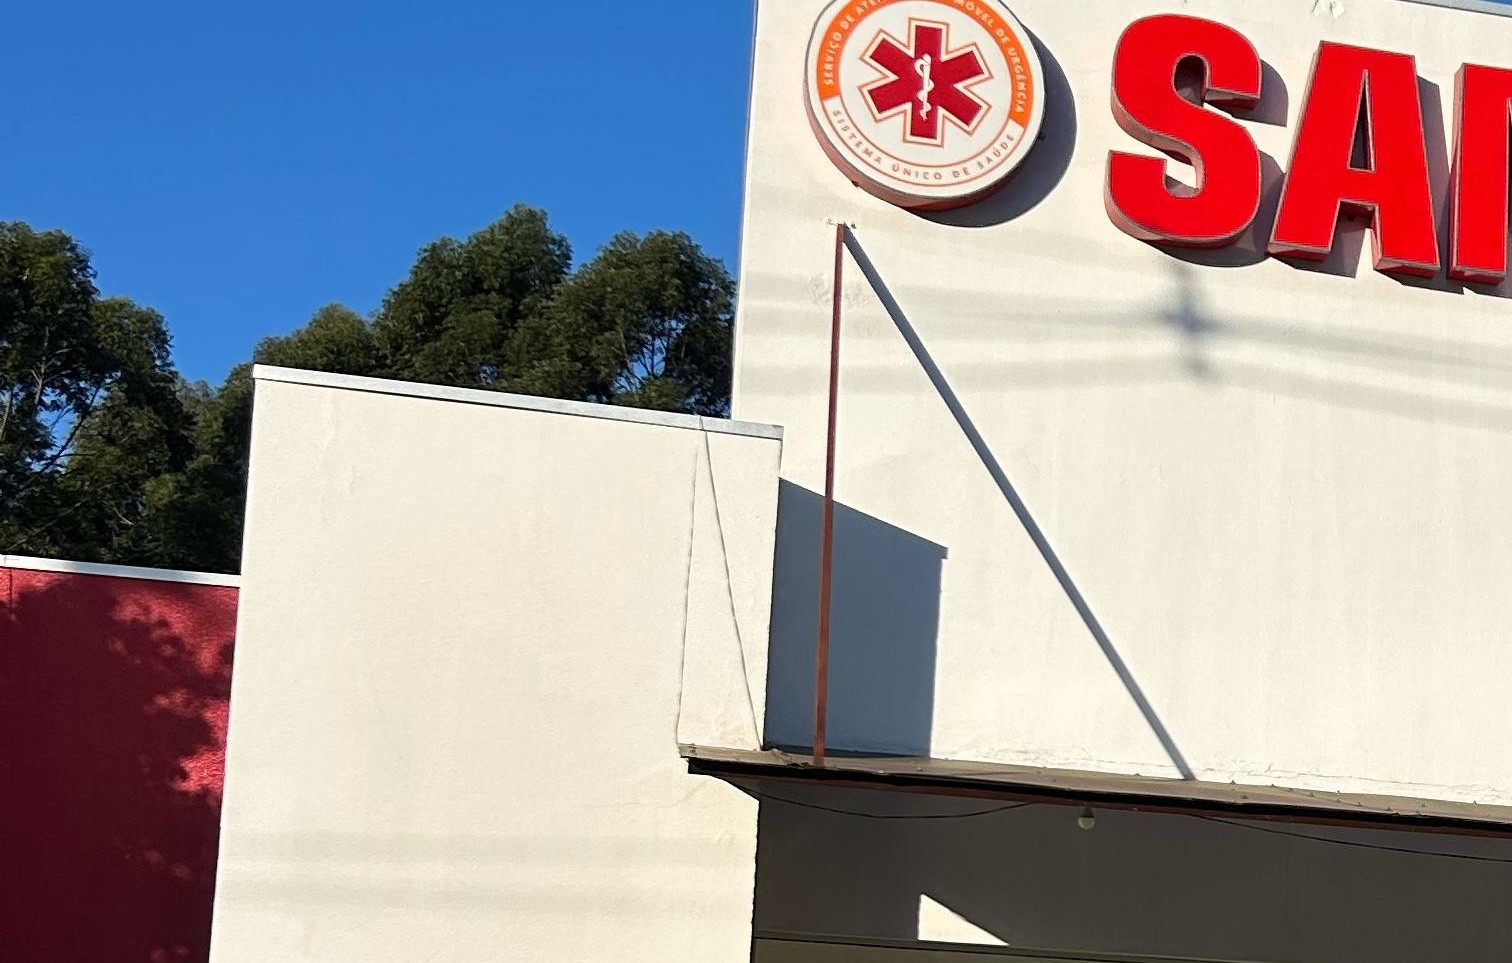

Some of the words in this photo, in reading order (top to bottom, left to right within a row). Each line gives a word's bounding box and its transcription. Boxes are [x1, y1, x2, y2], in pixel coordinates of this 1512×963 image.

[995, 27, 1010, 45] DE
[832, 108, 883, 165] SISTEMA
[891, 161, 943, 180] ÚNICO
[952, 167, 970, 179] DE
[977, 133, 1015, 170] SAÚDE
